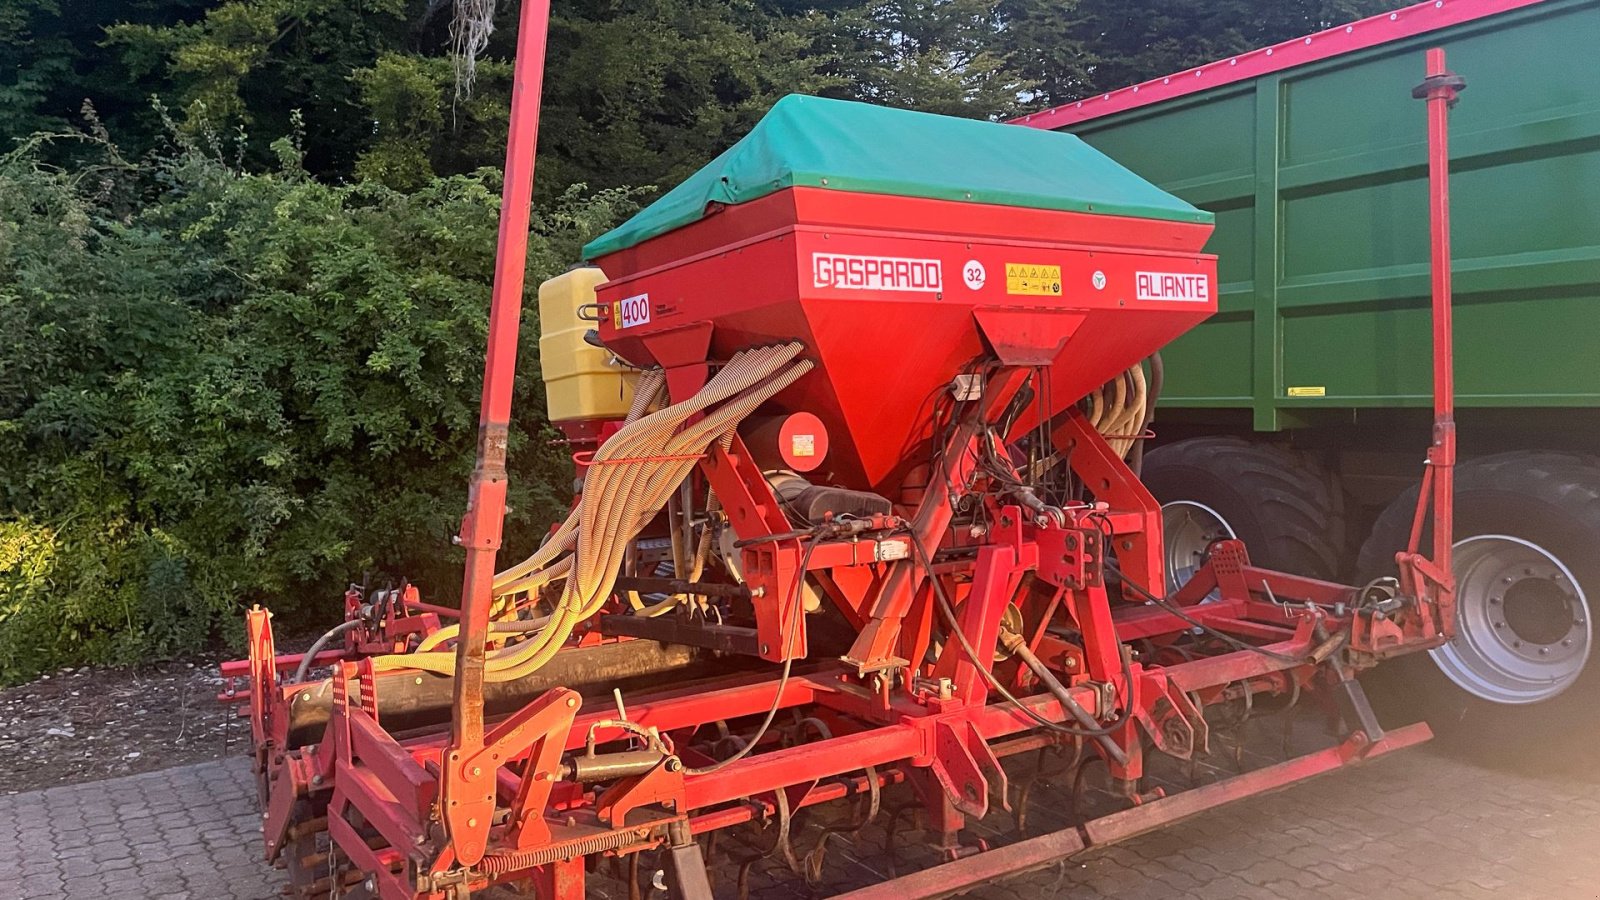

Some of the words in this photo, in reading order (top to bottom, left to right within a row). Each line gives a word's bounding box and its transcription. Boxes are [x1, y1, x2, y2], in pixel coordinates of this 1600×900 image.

[816, 256, 940, 288] GASPARDO
[967, 268, 982, 282] 32
[1138, 274, 1206, 298] ALIANTE
[623, 298, 648, 324] 400
